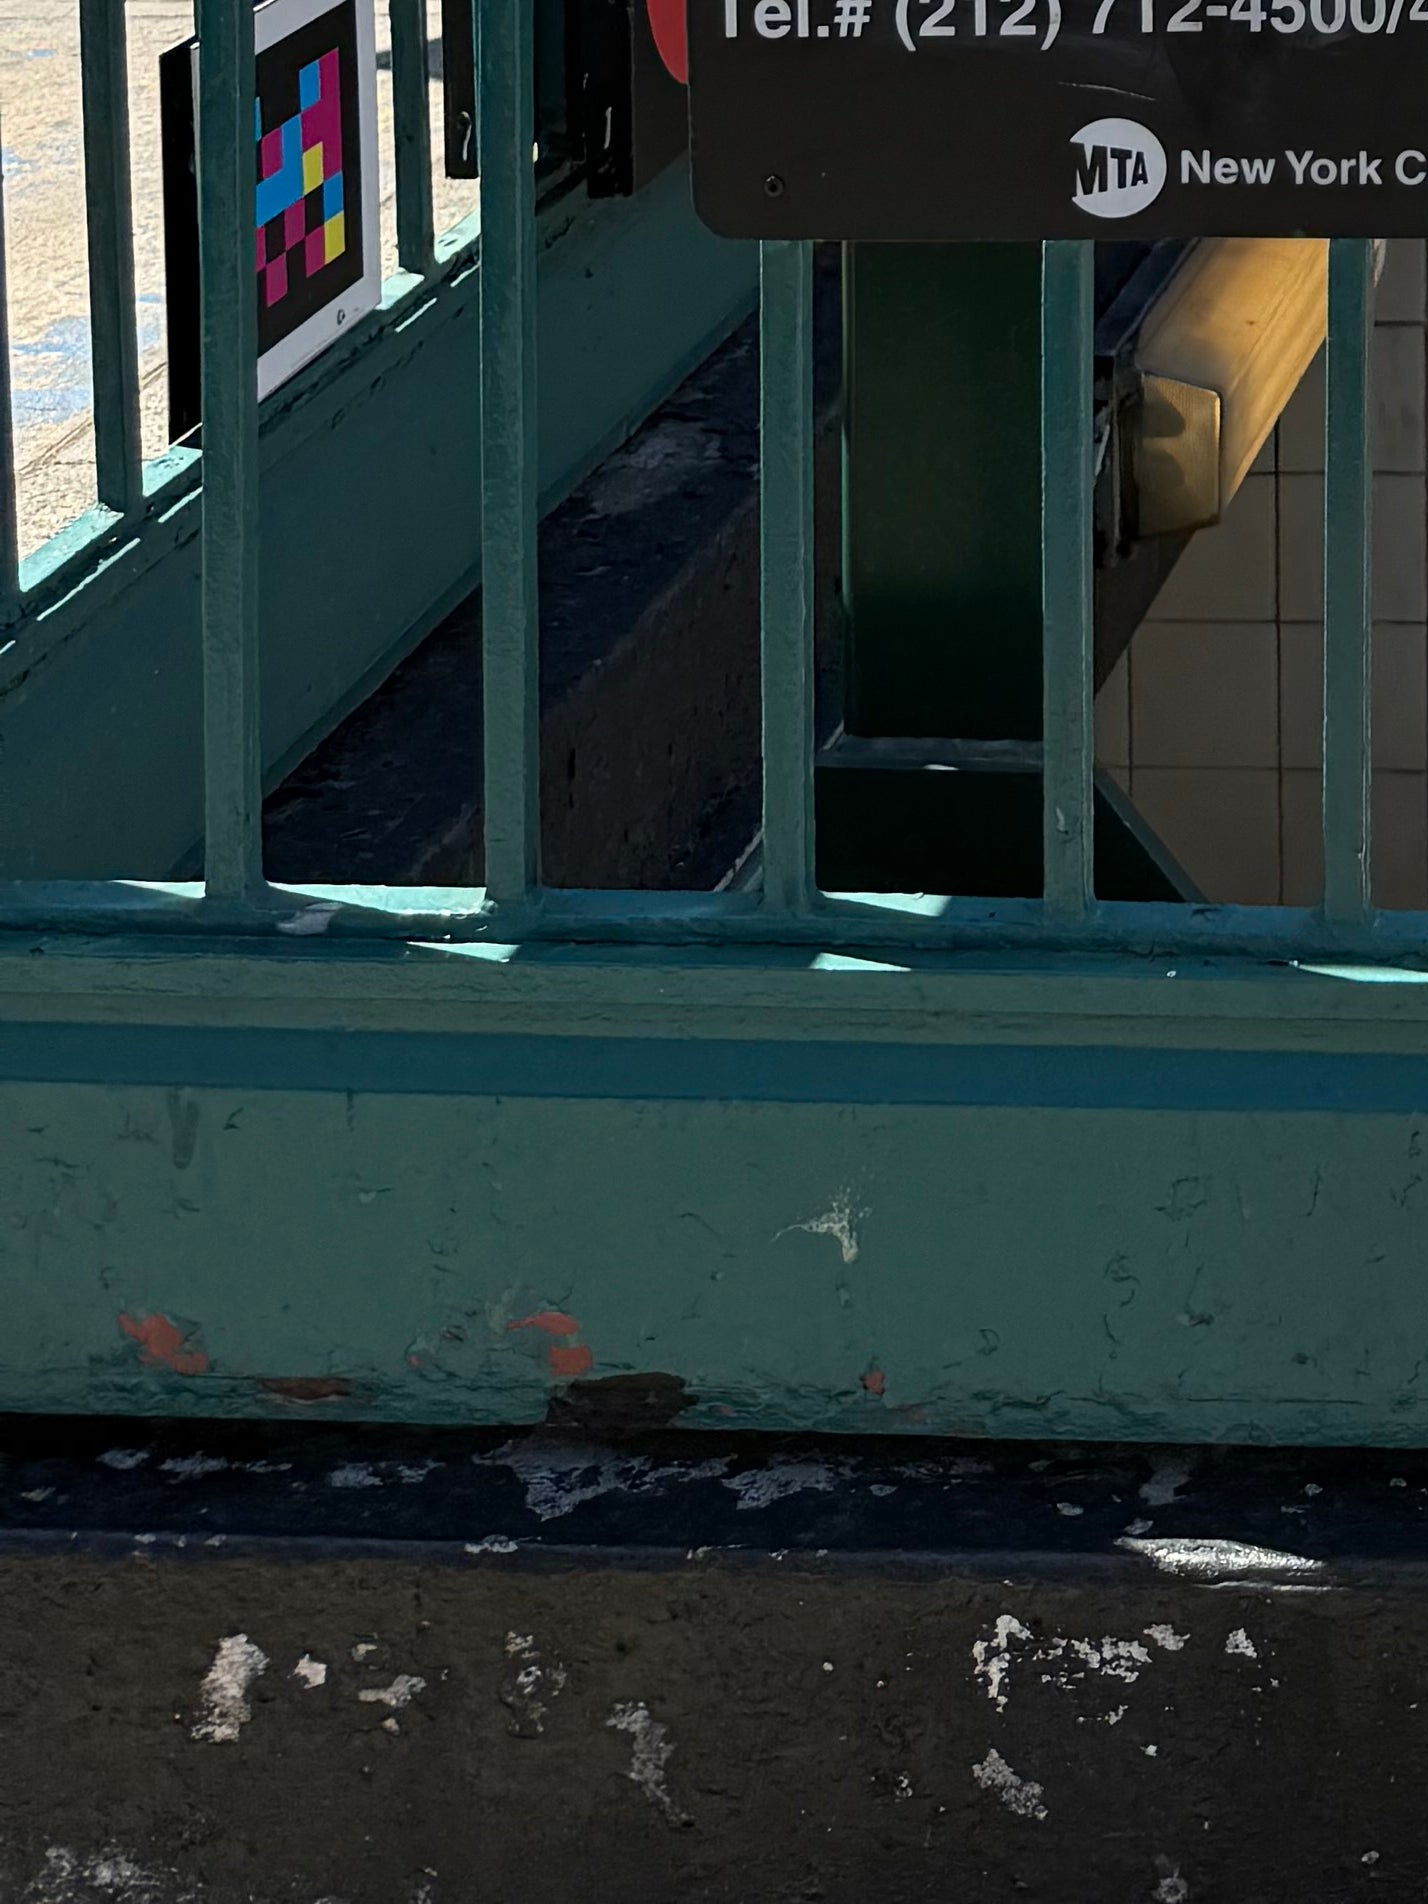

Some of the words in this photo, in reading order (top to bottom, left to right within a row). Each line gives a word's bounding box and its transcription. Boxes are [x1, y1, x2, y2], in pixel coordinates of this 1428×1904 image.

[1073, 144, 1149, 199] MTA
[1180, 150, 1275, 185] New
[1286, 150, 1382, 185] York
